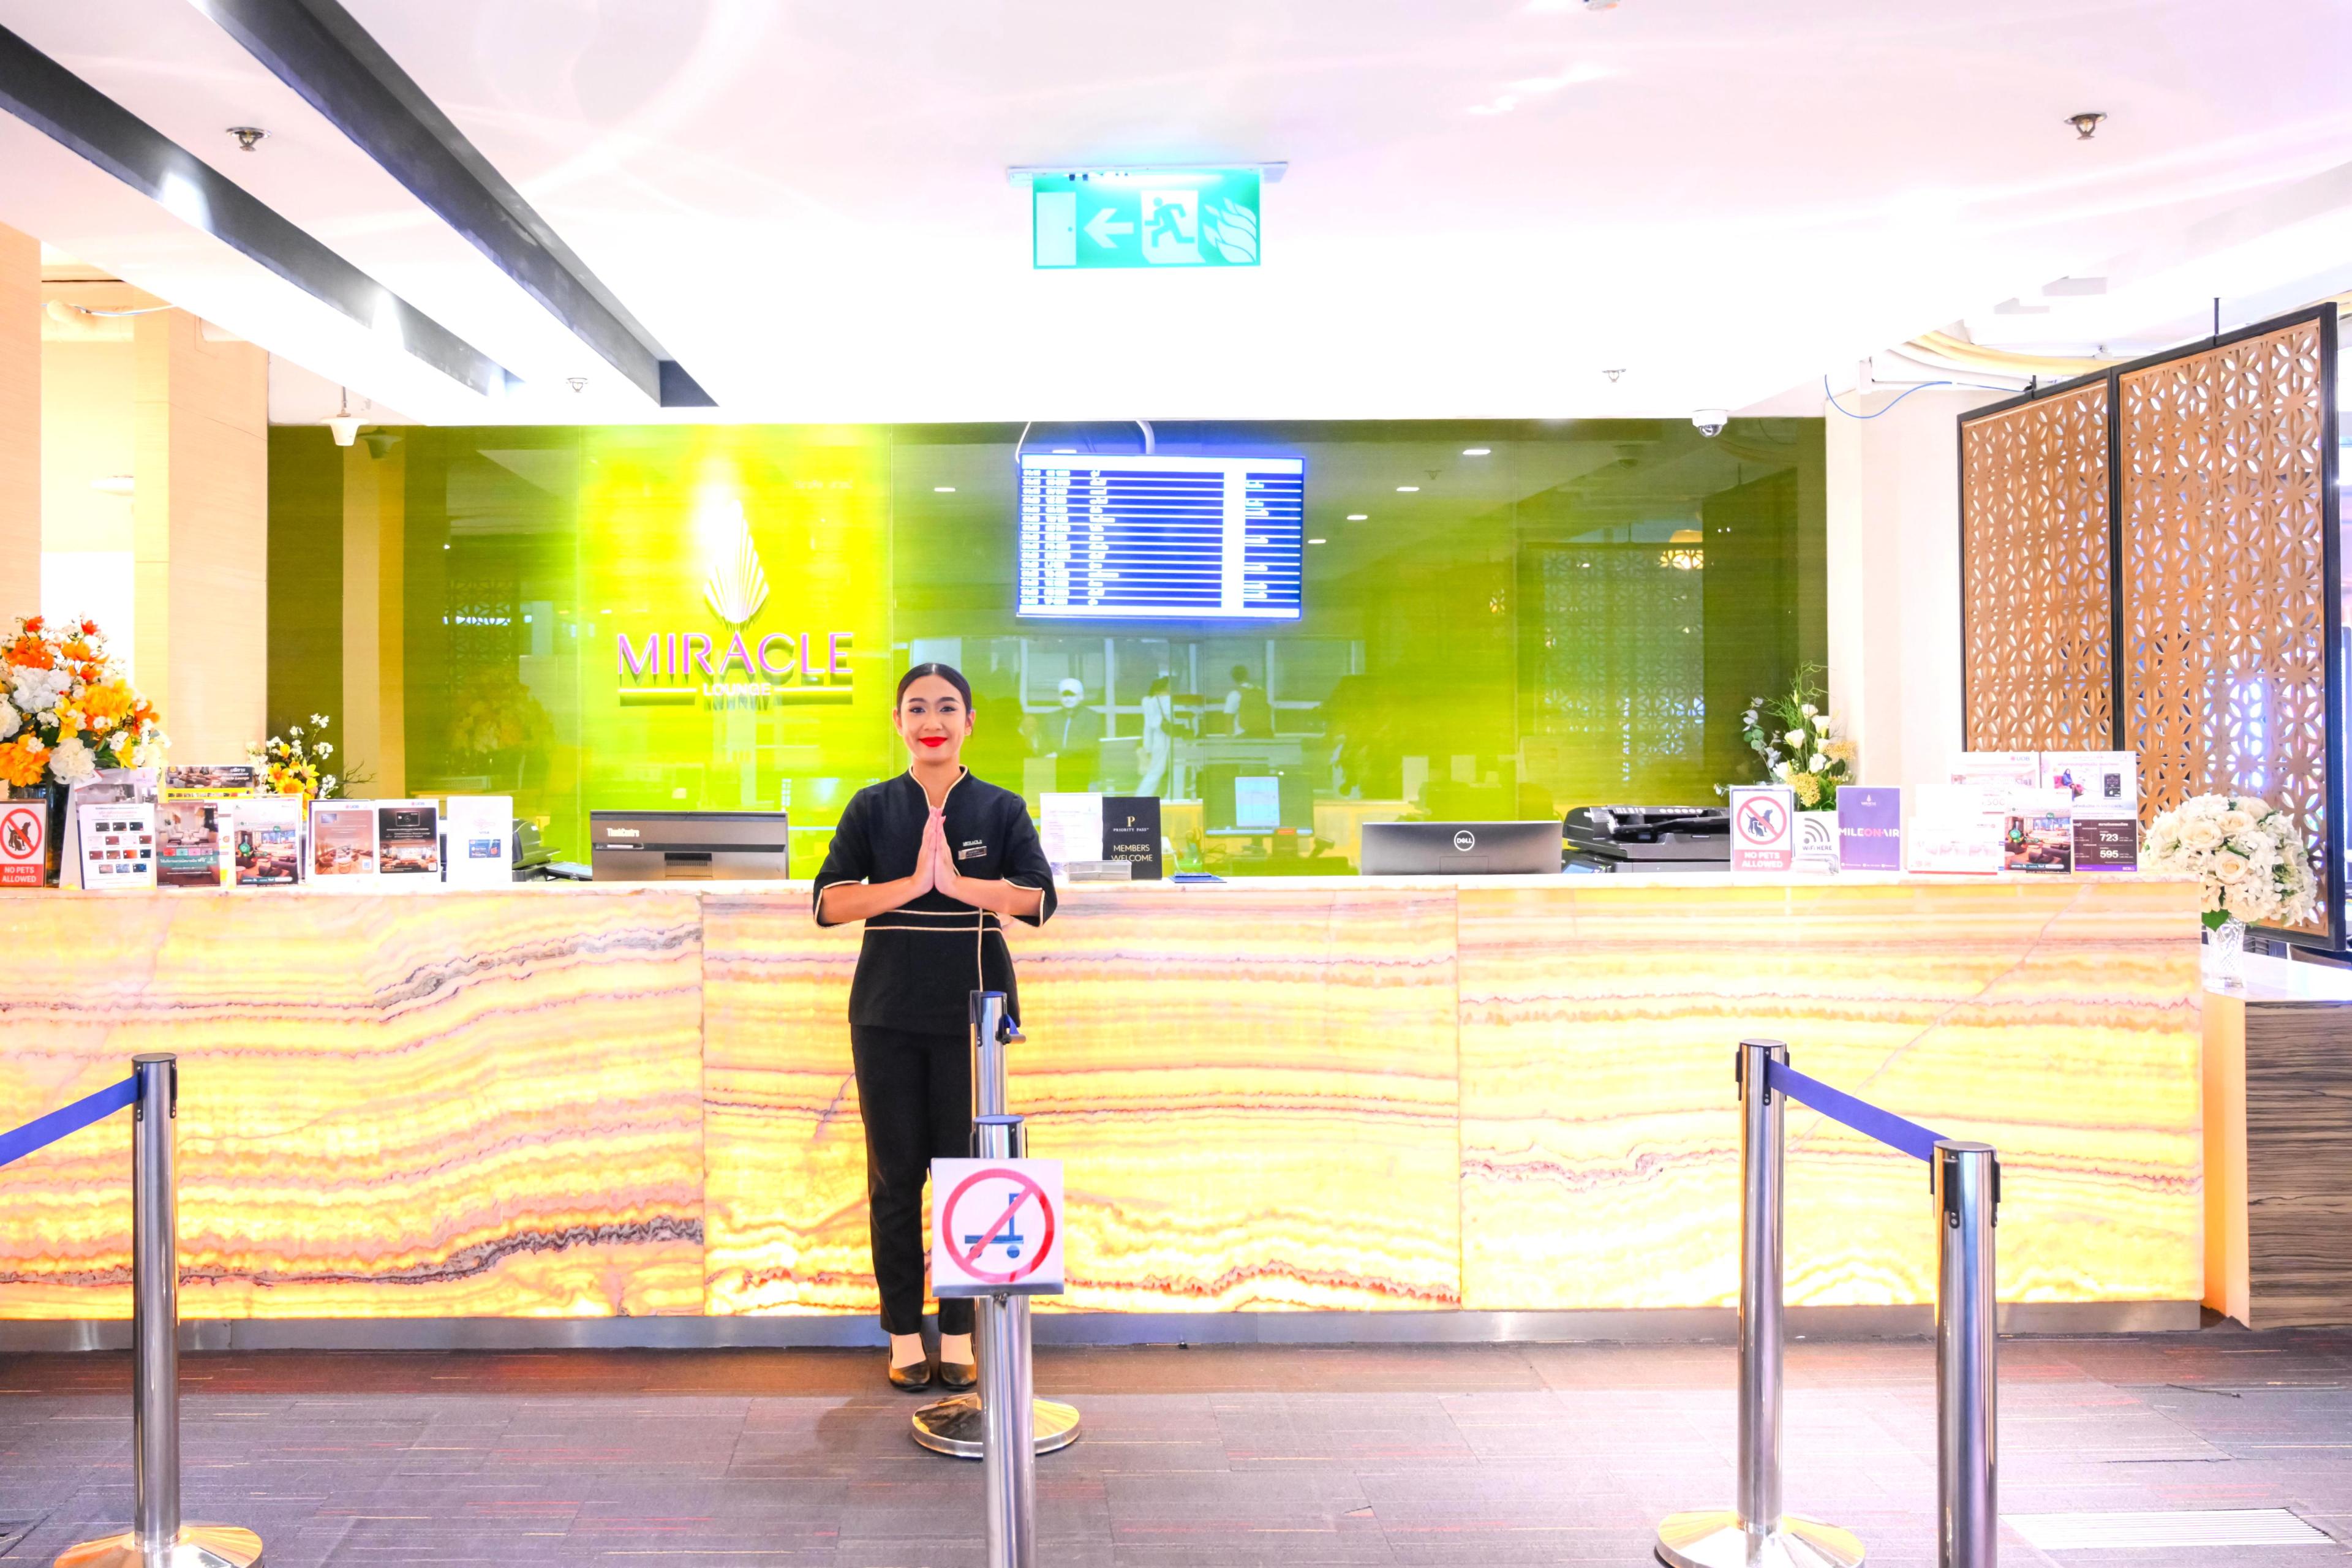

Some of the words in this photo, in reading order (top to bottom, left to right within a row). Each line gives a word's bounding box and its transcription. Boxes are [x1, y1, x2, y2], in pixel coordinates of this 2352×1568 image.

[617, 631, 853, 674] MIRACLE
[703, 682, 771, 696] LOUNGE
[1741, 860, 1784, 869] ALLOWED
[2, 875, 37, 883] ALLOWED
